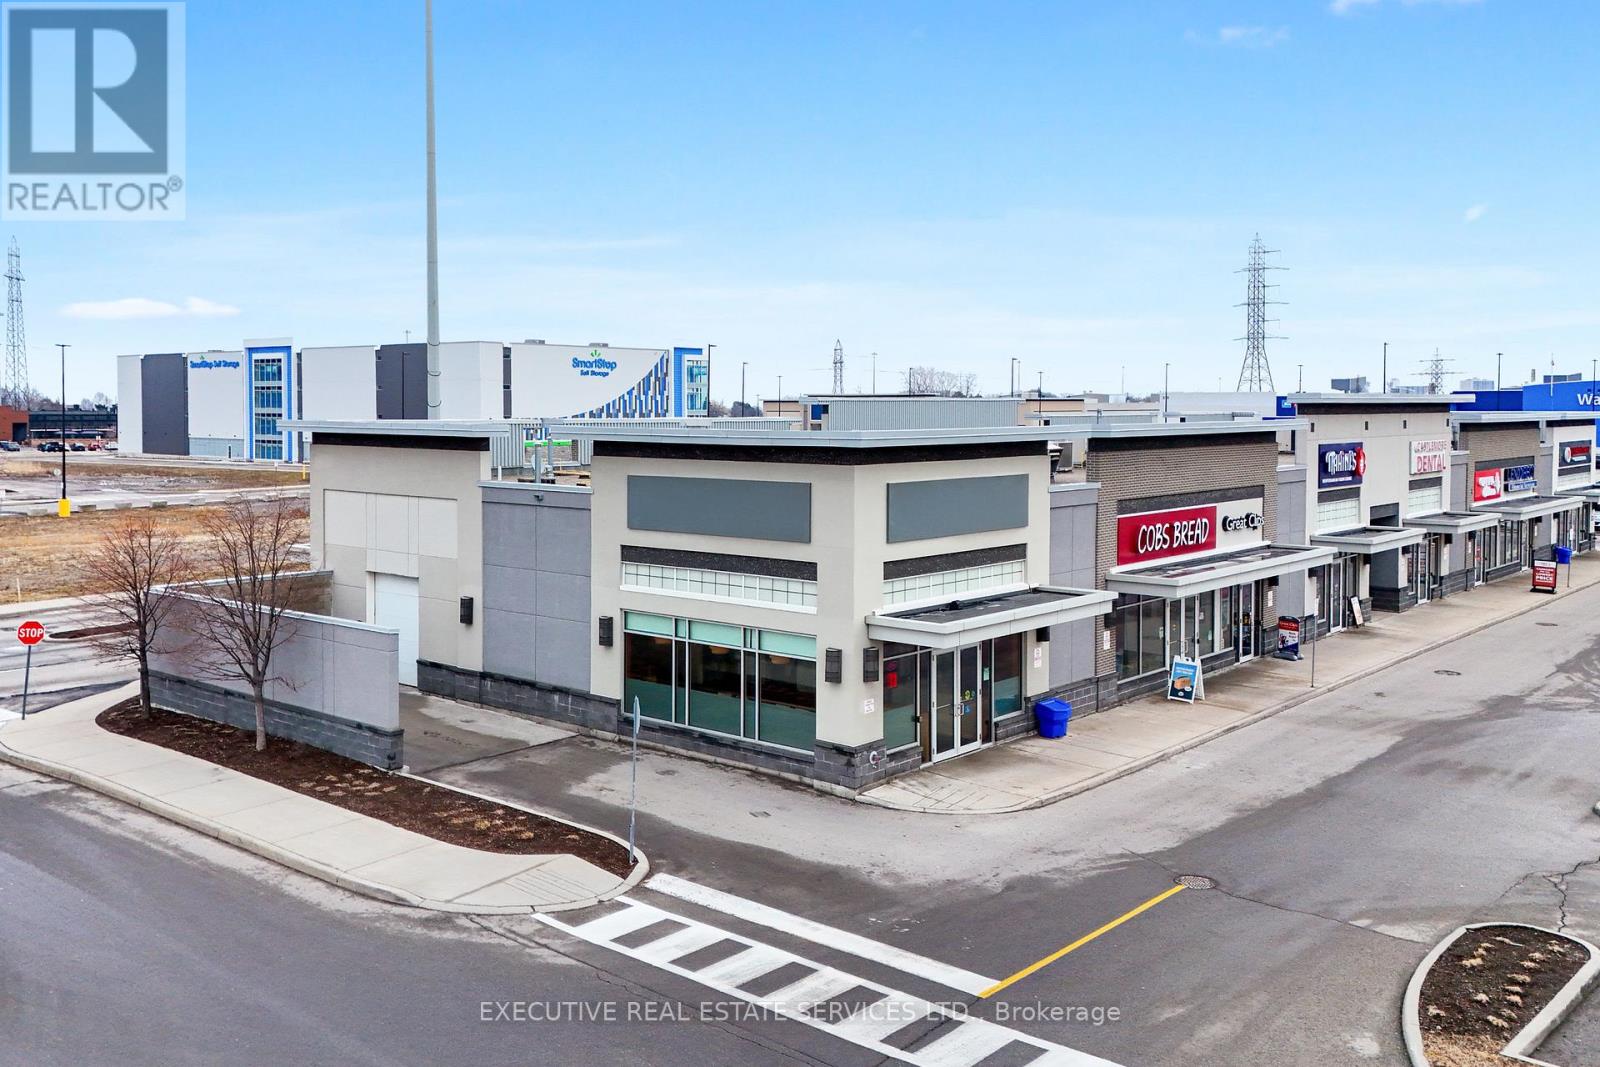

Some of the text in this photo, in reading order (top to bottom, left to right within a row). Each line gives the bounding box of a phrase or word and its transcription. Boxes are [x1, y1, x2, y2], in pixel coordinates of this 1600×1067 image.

[572, 357, 617, 371] SmartStop
[1416, 454, 1446, 472] DENTAL
[1223, 515, 1247, 532] Great
[1137, 517, 1210, 554] COBS BREAD
[19, 628, 44, 638] STOP
